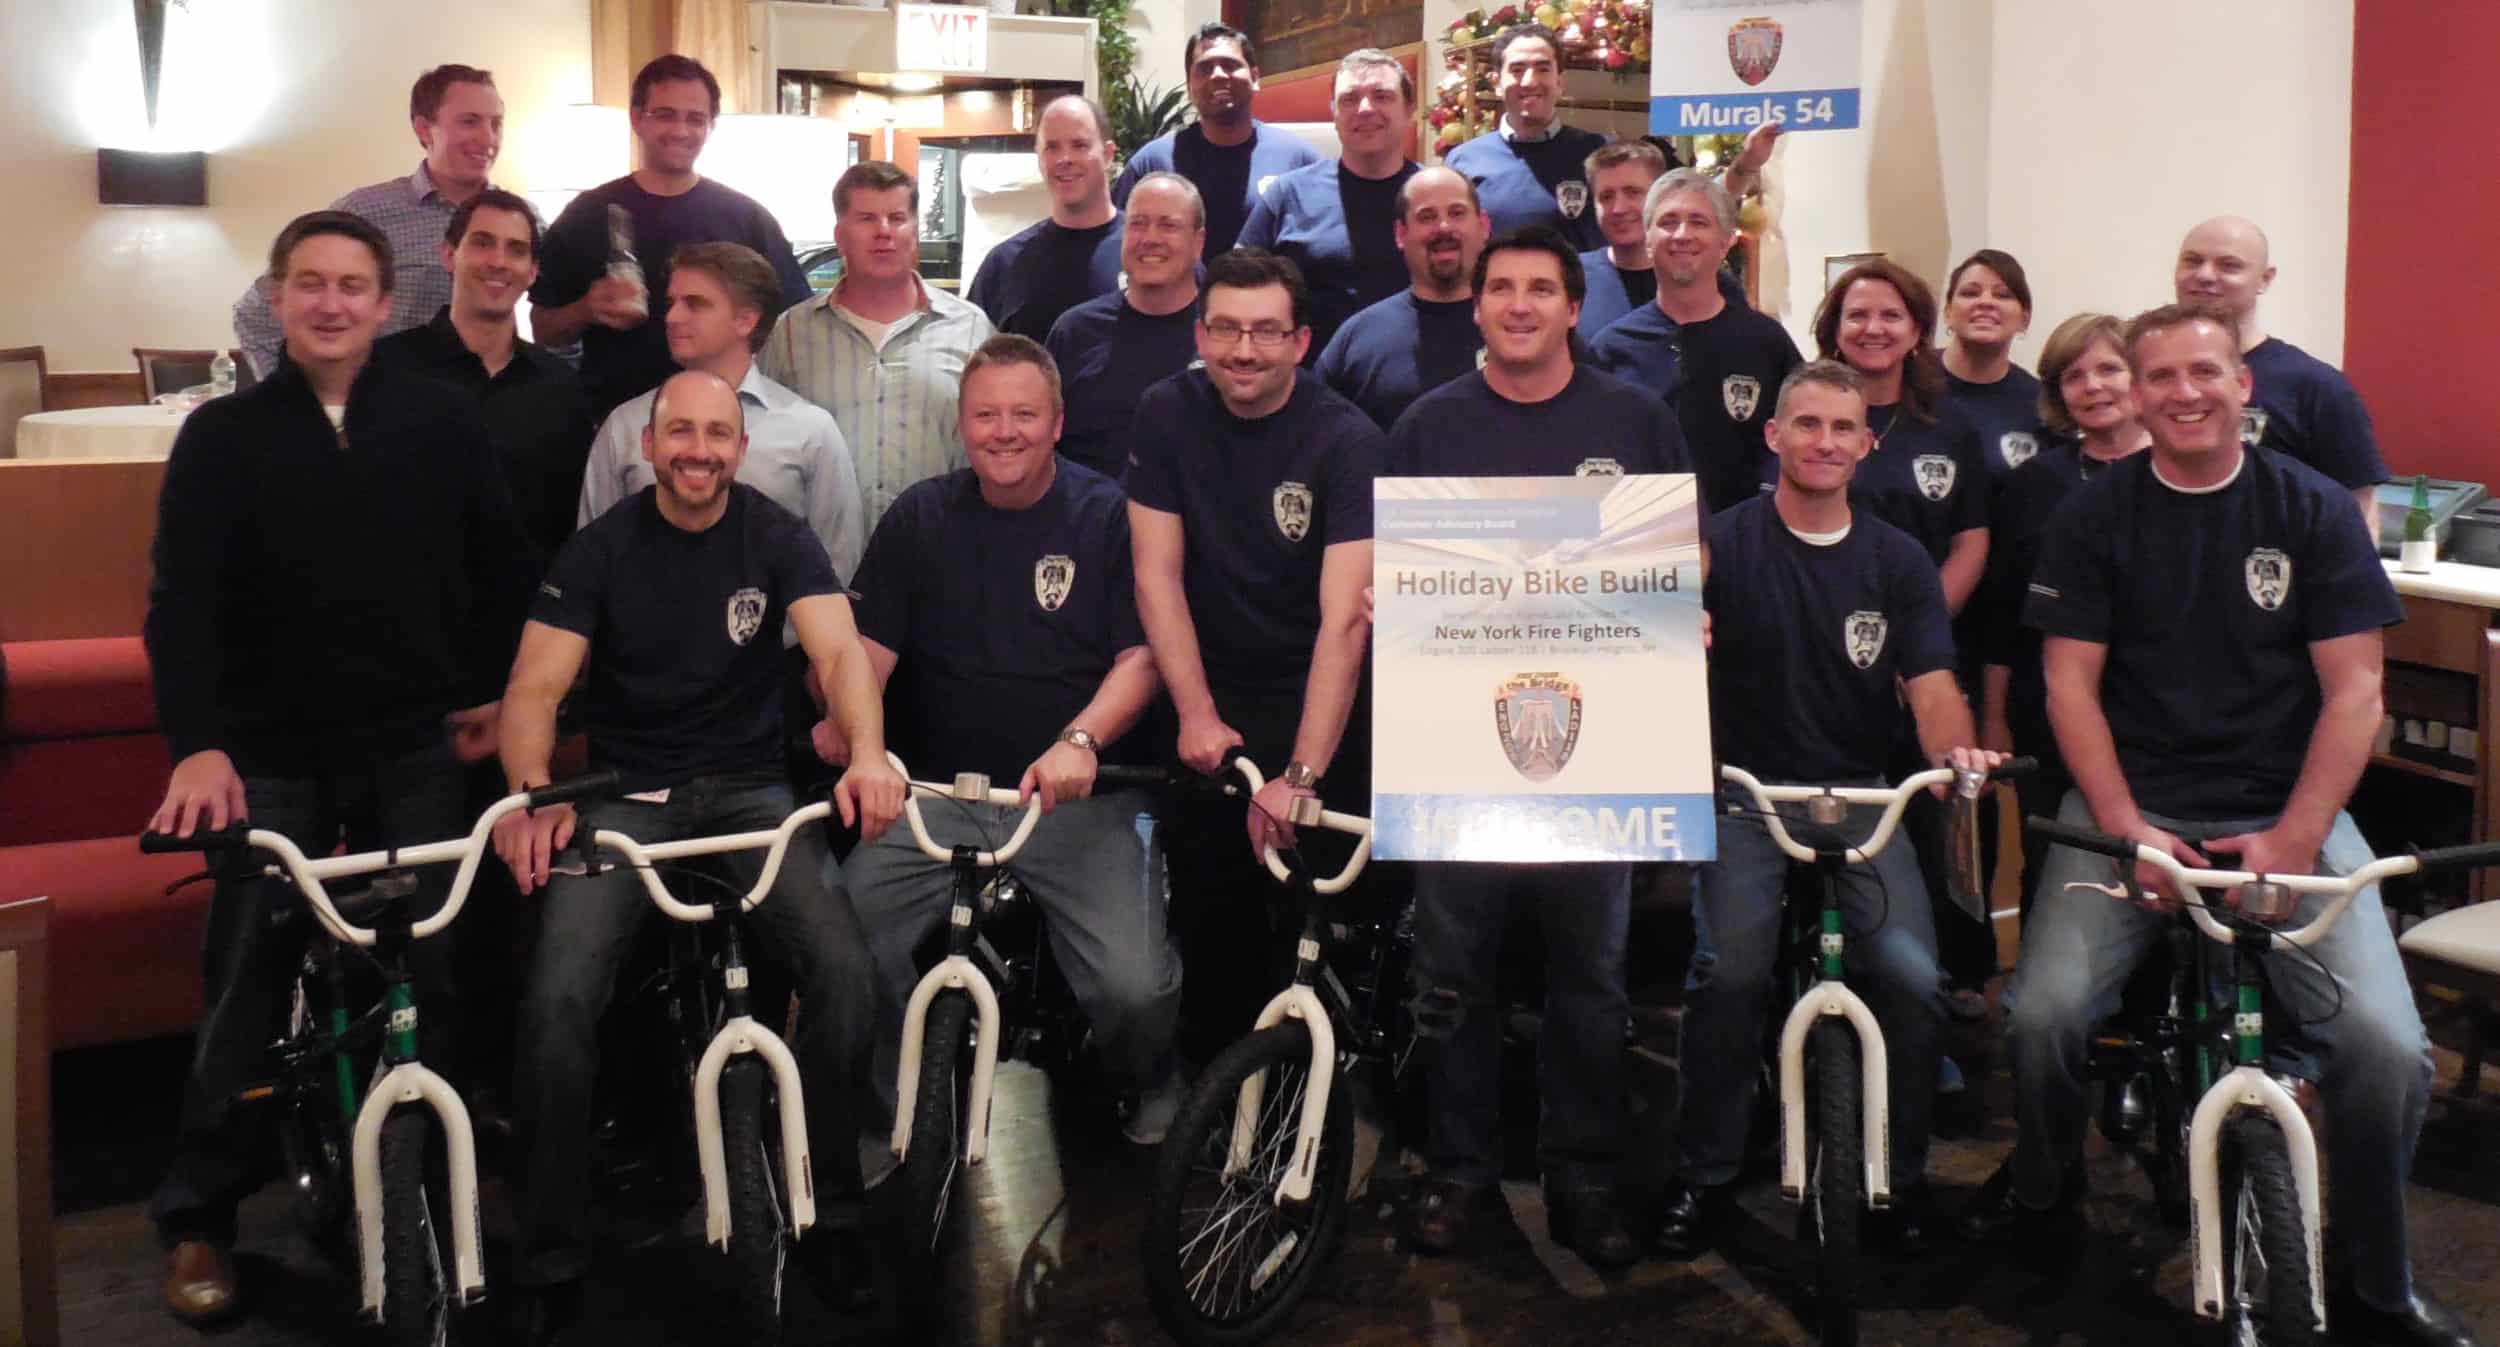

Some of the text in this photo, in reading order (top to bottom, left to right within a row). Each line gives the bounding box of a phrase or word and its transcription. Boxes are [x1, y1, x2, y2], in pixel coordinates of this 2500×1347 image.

[1680, 97, 1835, 127] Murals 54
[1396, 567, 1680, 601] Holiday Bike Build
[1434, 623, 1641, 642] New York Fire Fighters
[1529, 679, 1569, 692] Bridge
[1412, 807, 1681, 849] WOME
